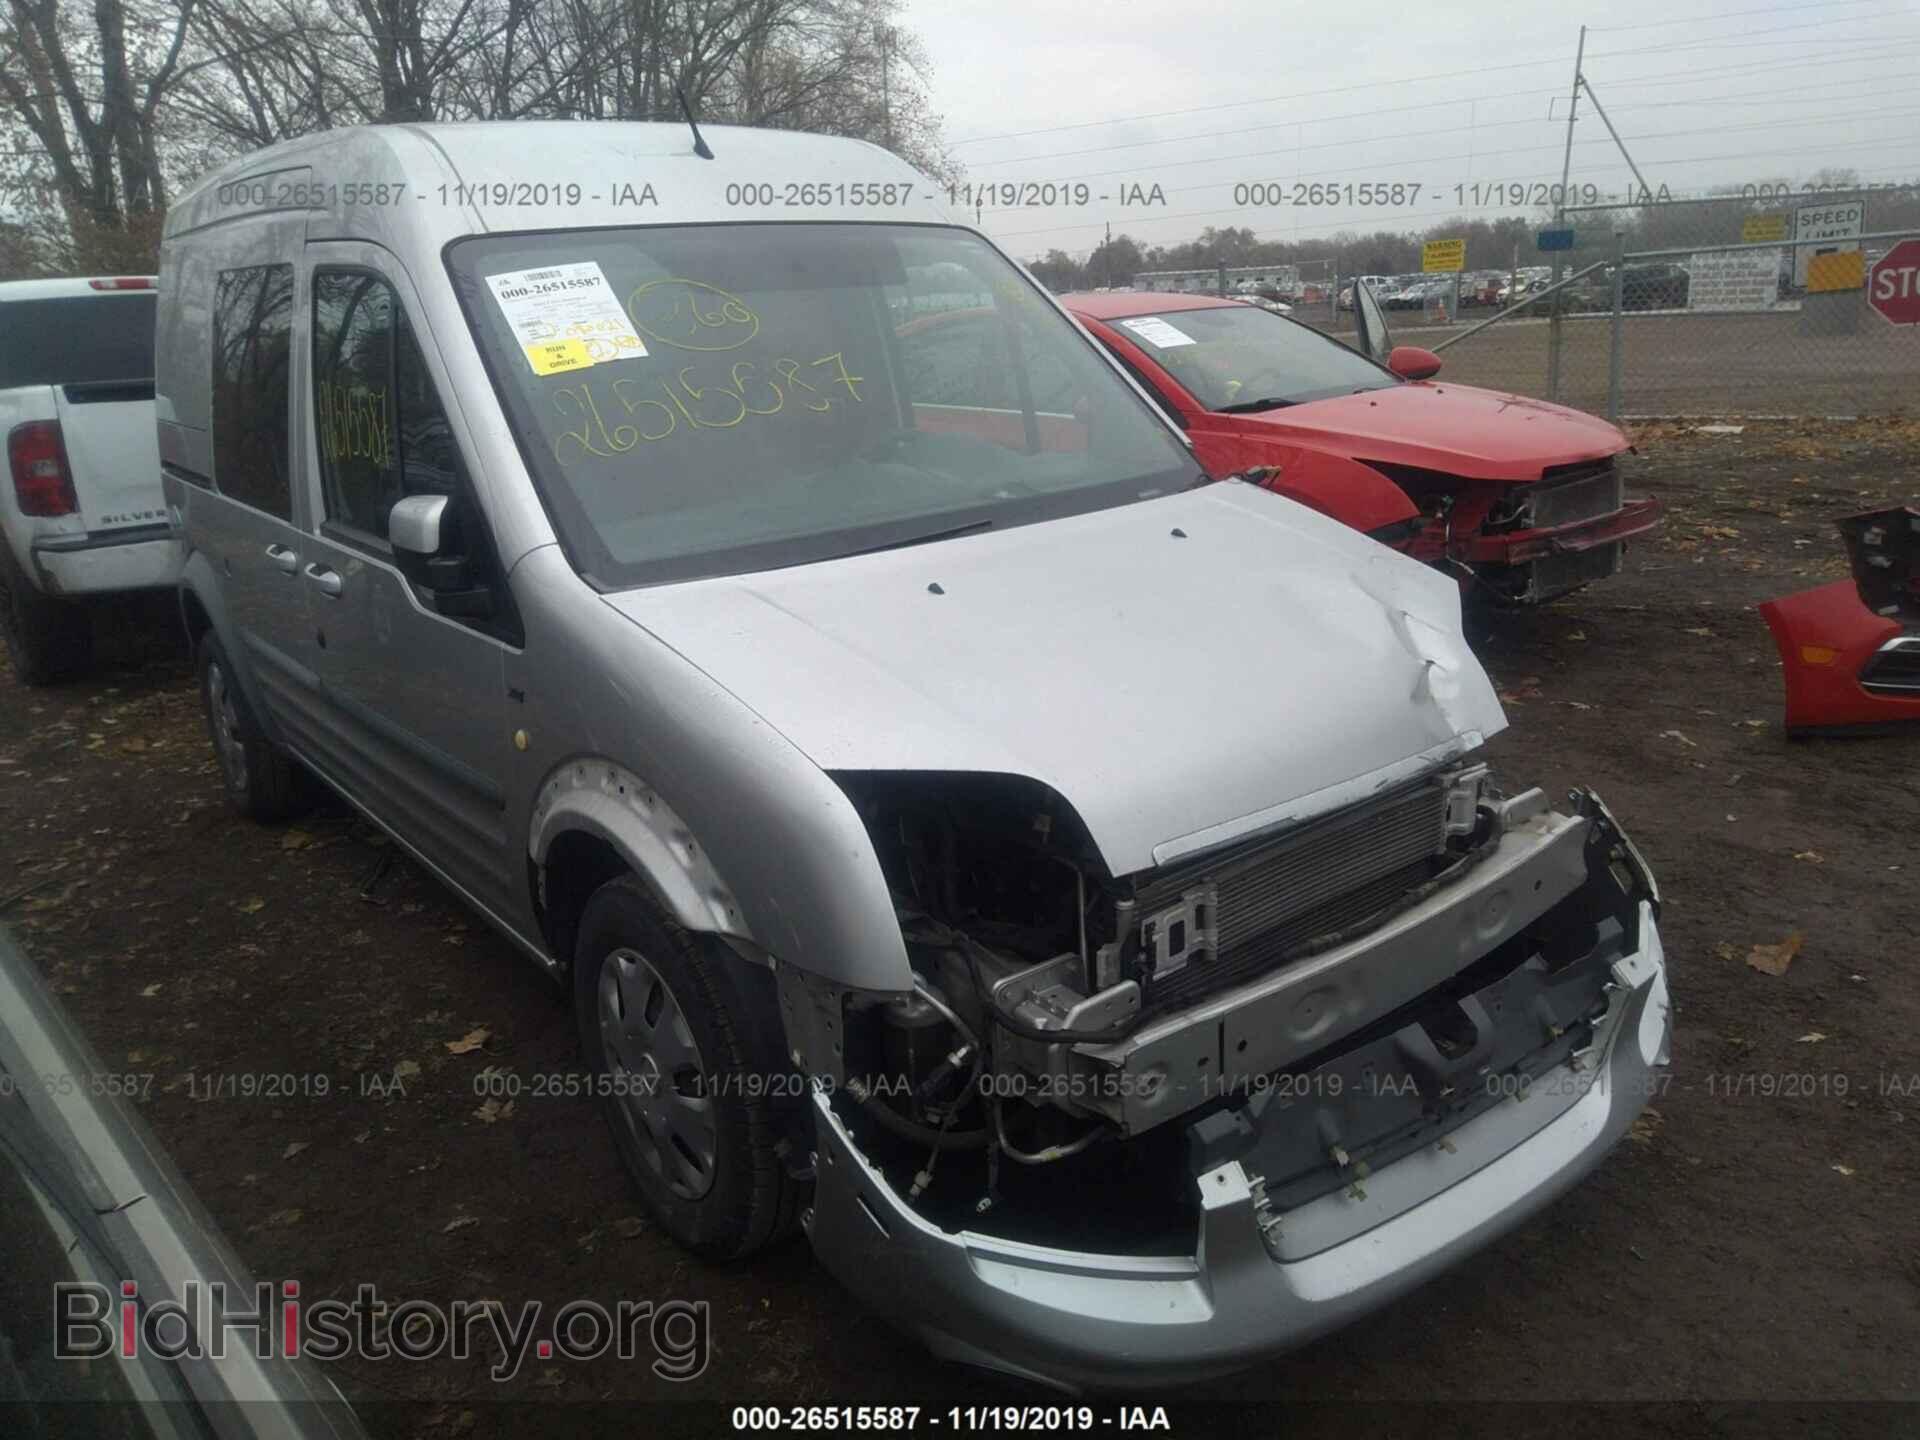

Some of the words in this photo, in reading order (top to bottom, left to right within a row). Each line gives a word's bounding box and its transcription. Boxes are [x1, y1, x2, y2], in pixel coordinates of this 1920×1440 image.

[1801, 209, 1858, 226] SPEED
[500, 277, 600, 300] 000-26515587
[1876, 267, 1920, 300] ST
